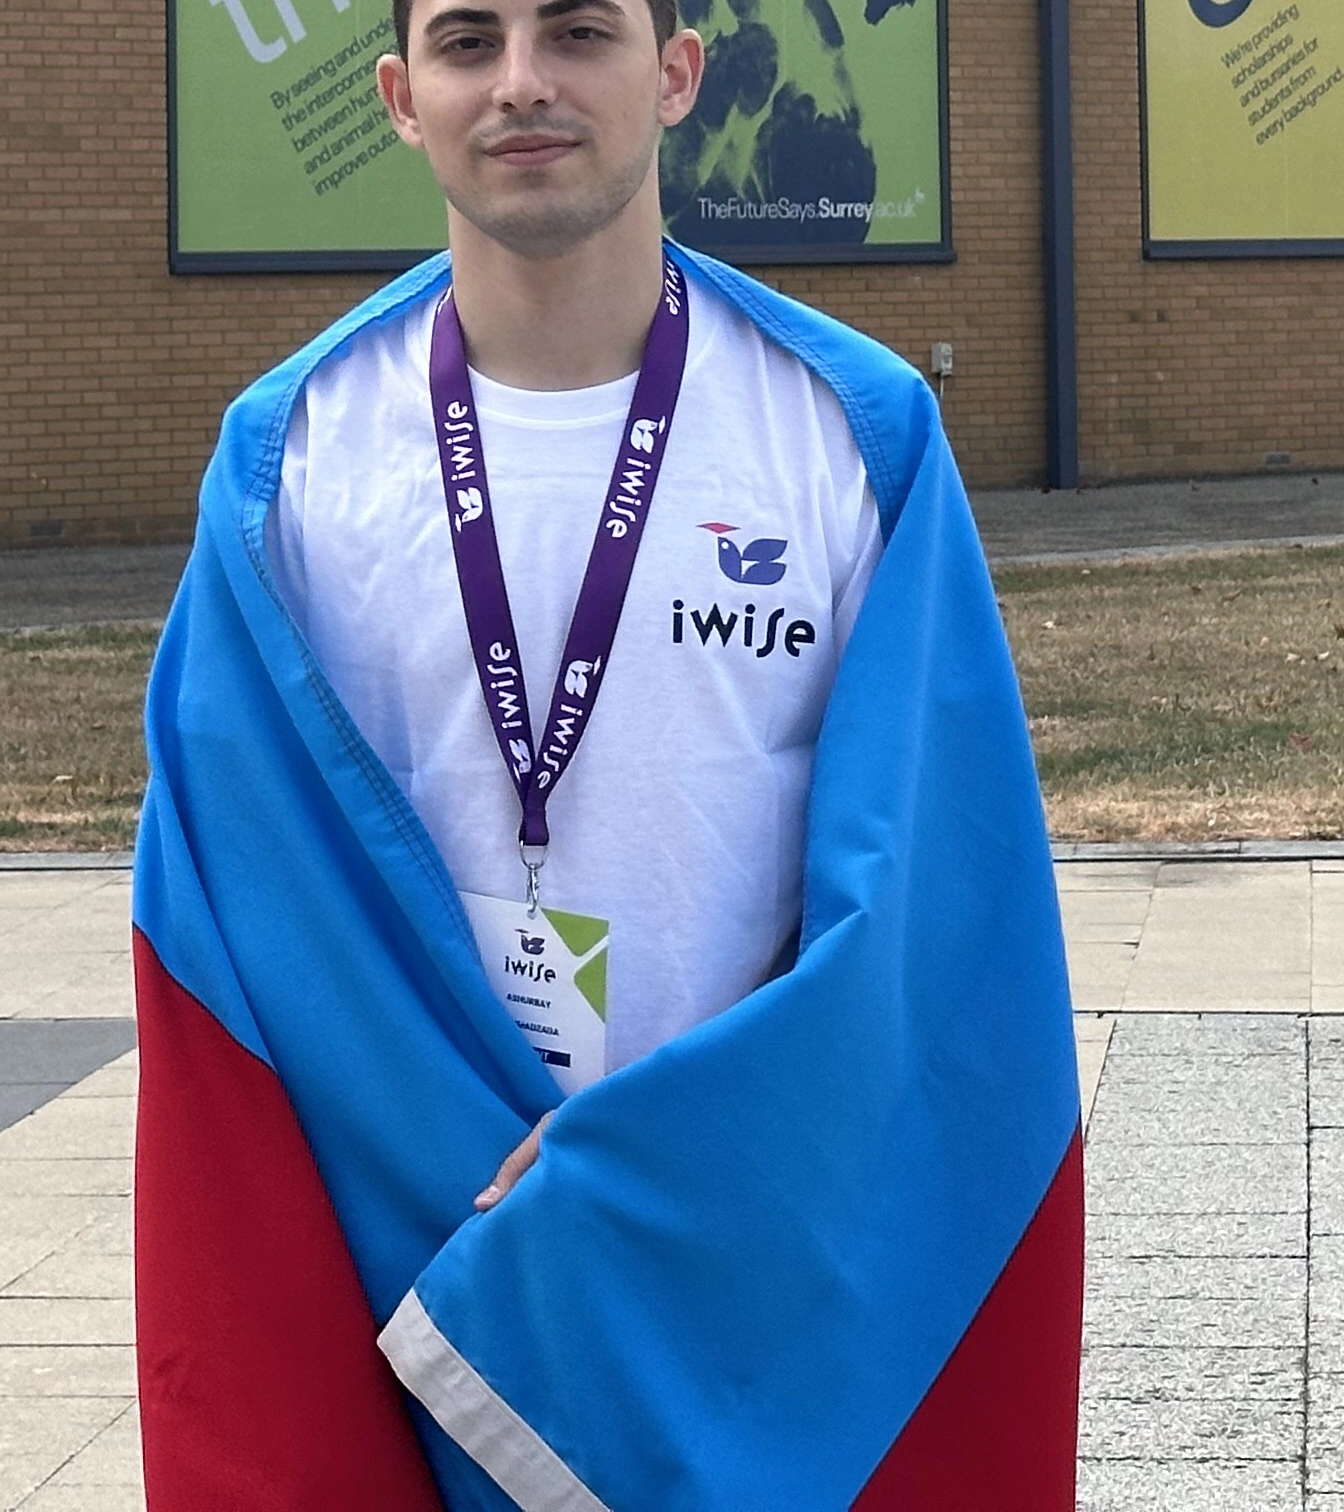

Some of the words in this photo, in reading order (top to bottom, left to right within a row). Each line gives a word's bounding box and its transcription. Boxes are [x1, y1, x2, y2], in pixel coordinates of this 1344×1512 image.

[270, 90, 291, 109] By
[698, 196, 916, 223] TheFutureSays.Surrey.ac.uk
[445, 401, 476, 481] iwise
[606, 457, 651, 538] iwise
[672, 599, 816, 658] iwise
[487, 641, 522, 729] iwise
[504, 955, 556, 982] iwise
